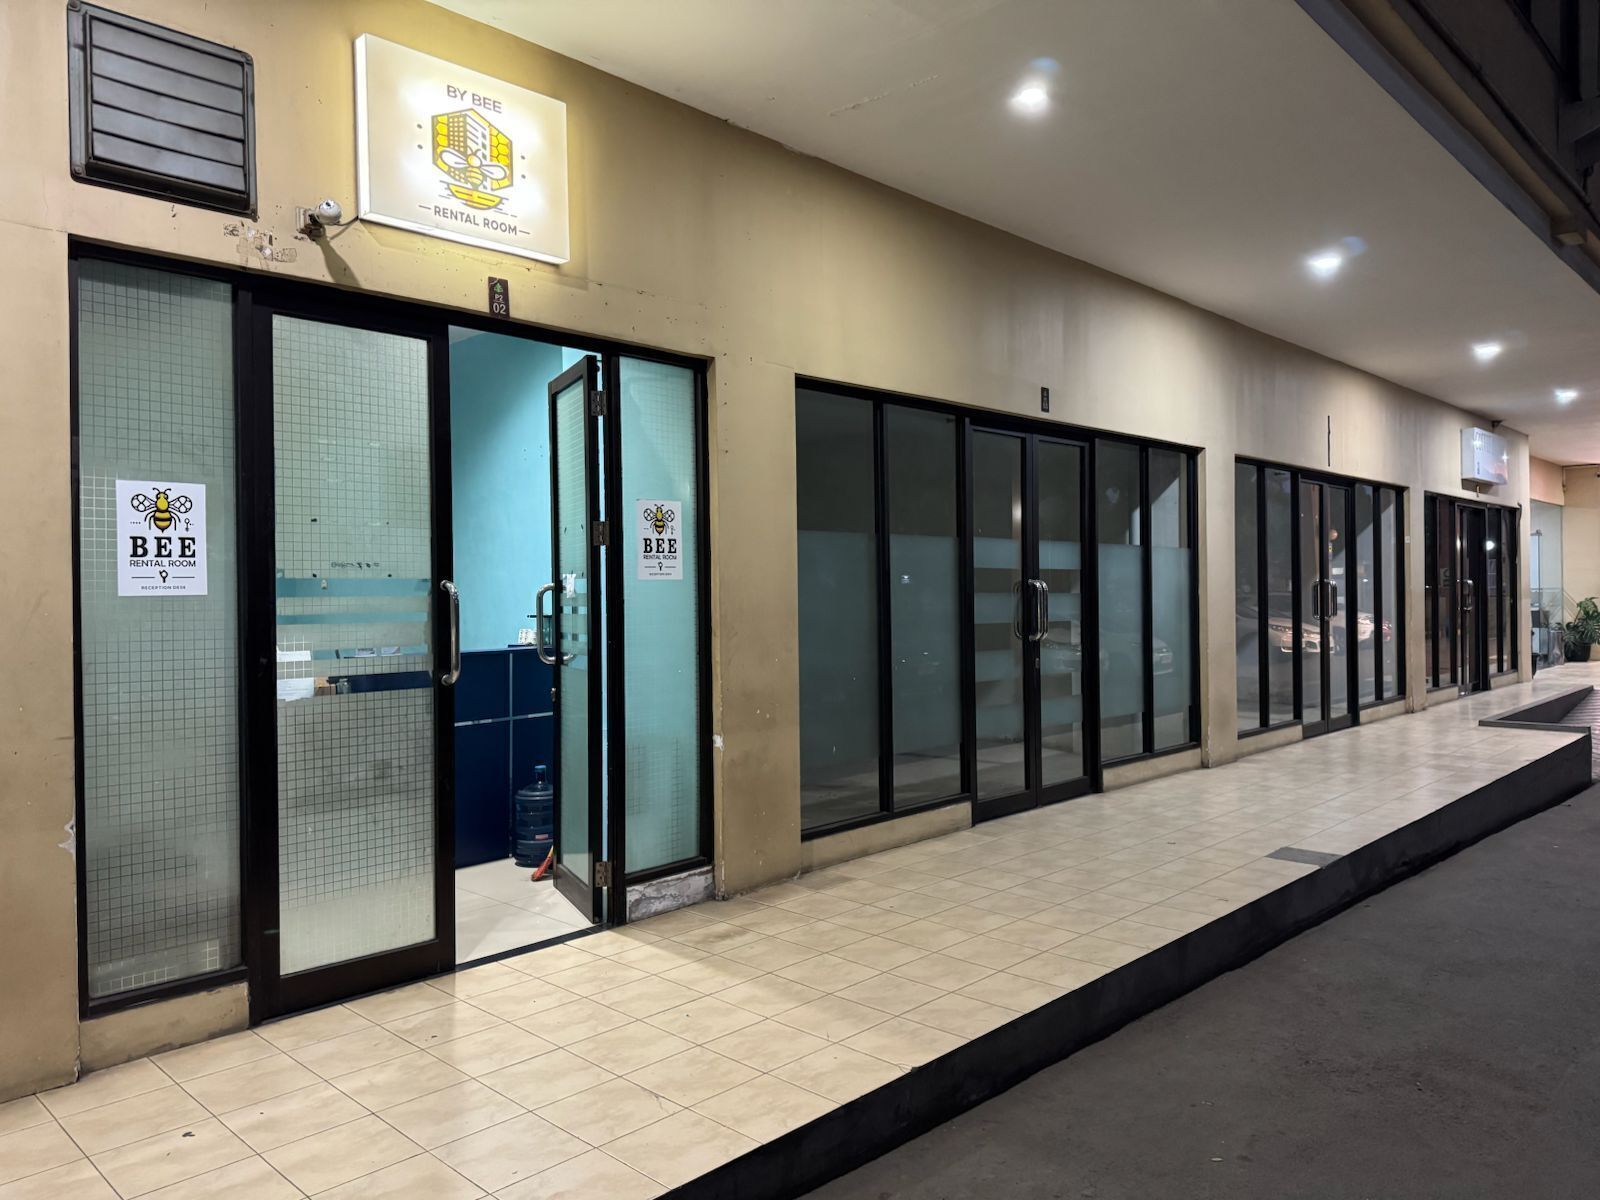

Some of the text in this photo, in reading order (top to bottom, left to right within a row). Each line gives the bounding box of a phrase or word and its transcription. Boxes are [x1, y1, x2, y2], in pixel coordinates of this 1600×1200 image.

[446, 84, 502, 114] BY BEE
[433, 205, 517, 236] RENTAL ROOM
[492, 302, 507, 315] 02
[129, 536, 196, 558] BEE
[643, 537, 677, 554] BEE
[129, 559, 196, 568] RENTAL ROOM
